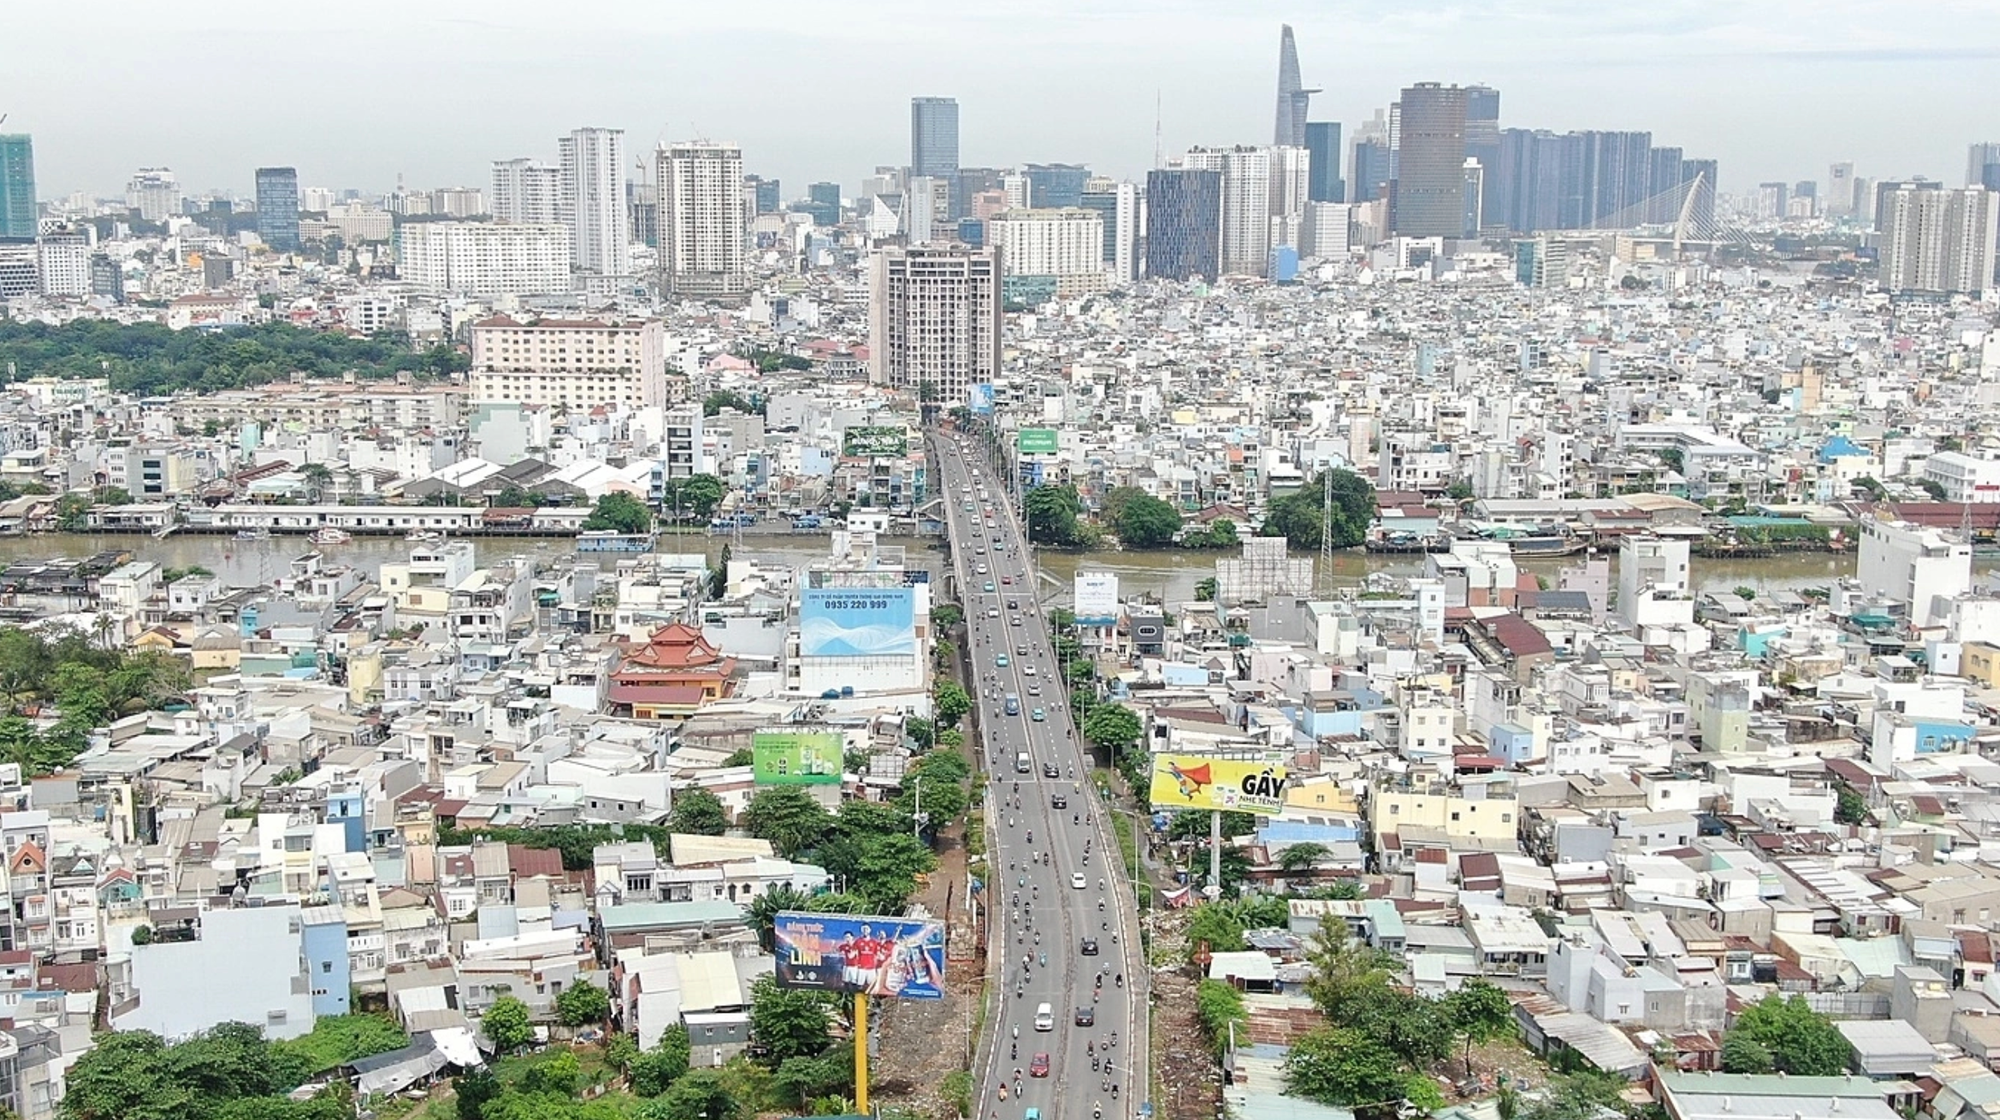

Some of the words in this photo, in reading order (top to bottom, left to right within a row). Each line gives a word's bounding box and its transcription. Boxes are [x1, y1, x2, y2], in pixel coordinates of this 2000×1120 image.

[825, 600, 848, 609] 0935
[850, 600, 868, 609] 220
[870, 600, 887, 609] 999
[1241, 767, 1286, 798] GẦY
